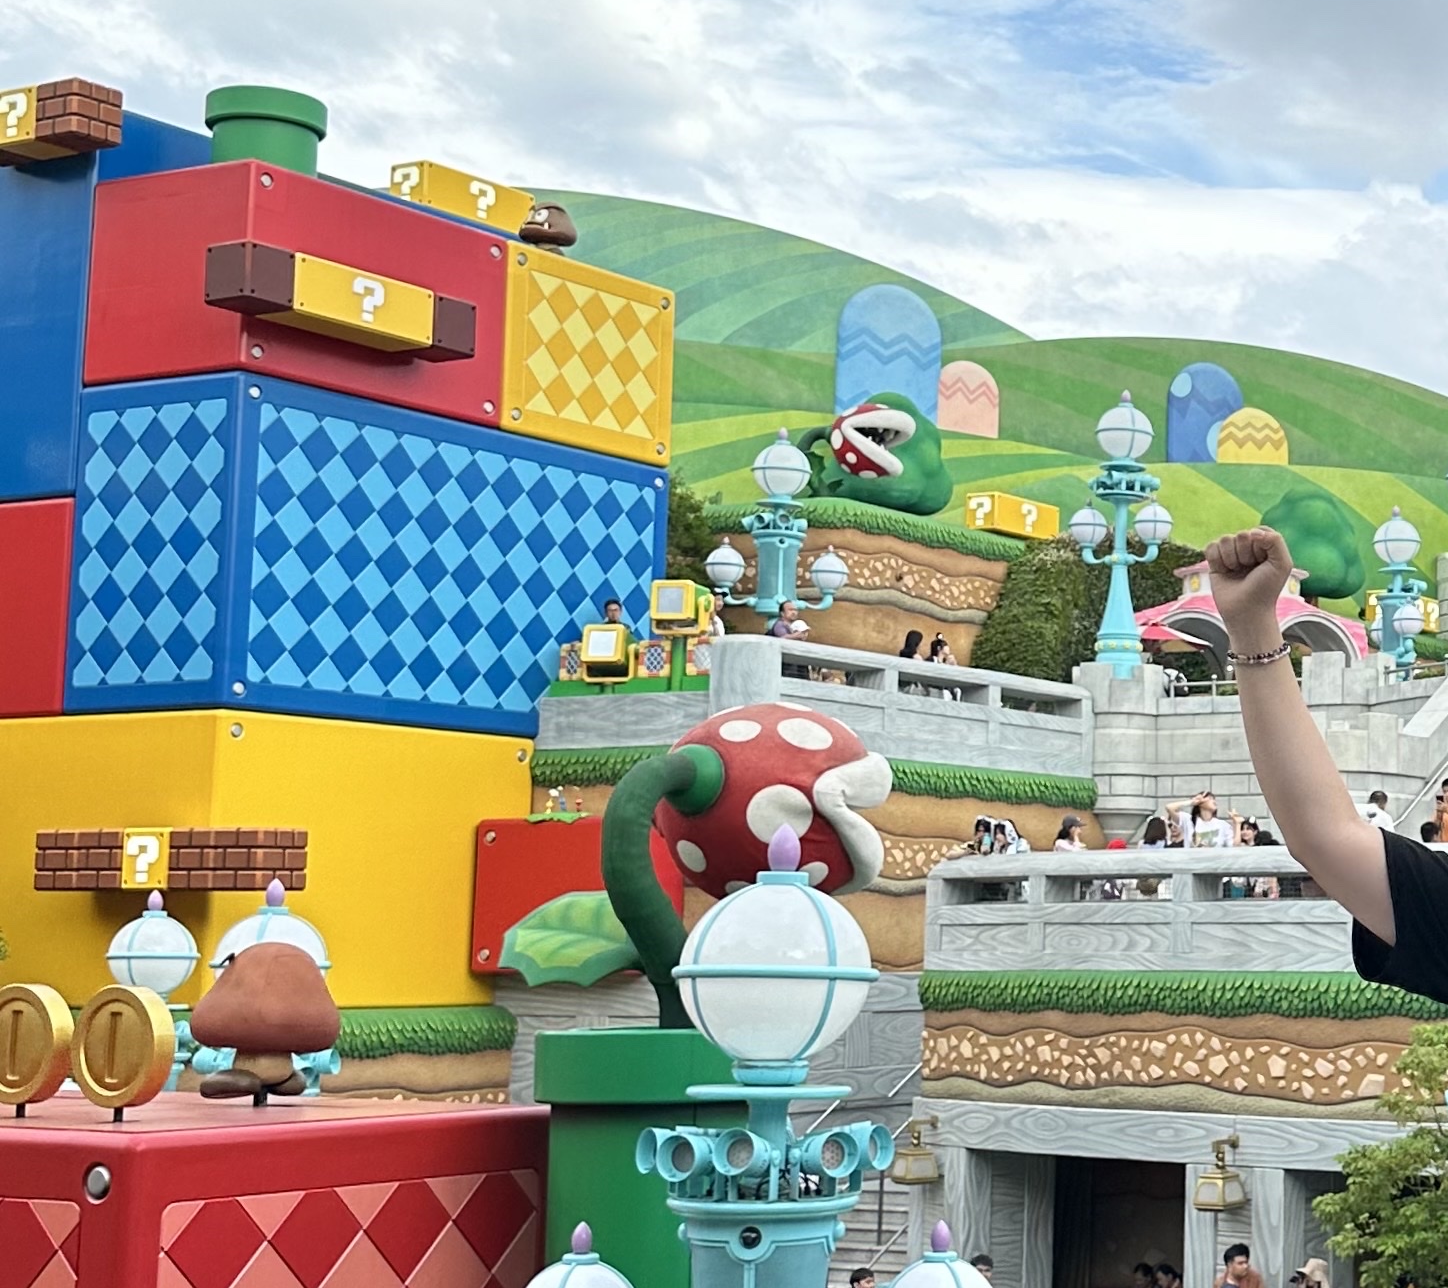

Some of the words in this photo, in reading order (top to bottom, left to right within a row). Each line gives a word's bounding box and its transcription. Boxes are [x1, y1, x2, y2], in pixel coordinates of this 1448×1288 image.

[0, 93, 28, 138] ?
[393, 166, 420, 201] ?
[469, 180, 496, 220] ?
[353, 276, 385, 323] ?
[969, 496, 992, 526] ?
[1021, 503, 1038, 533] ?
[126, 835, 160, 883] ?
